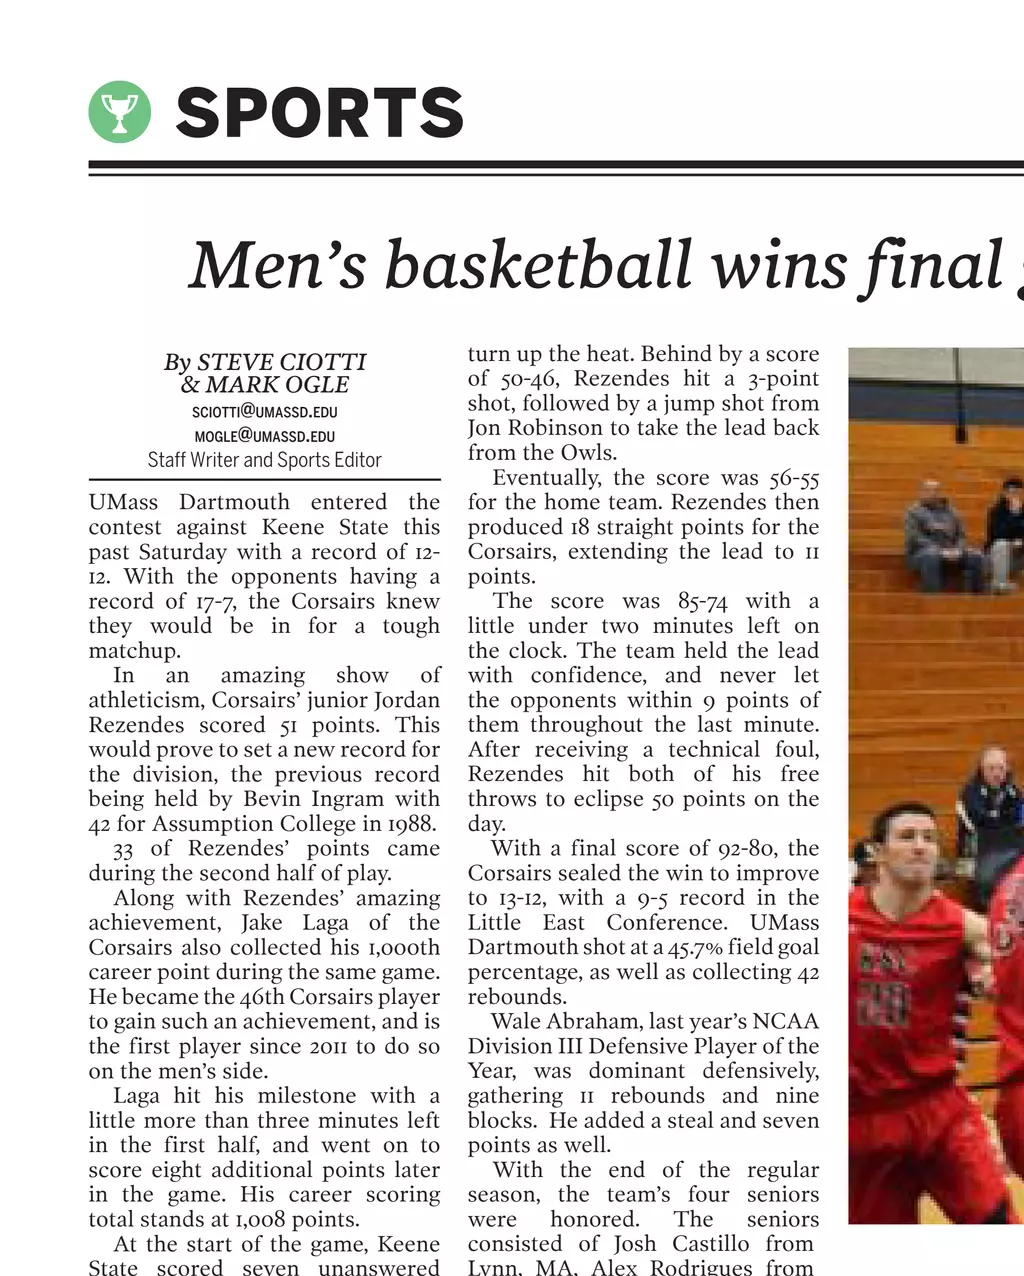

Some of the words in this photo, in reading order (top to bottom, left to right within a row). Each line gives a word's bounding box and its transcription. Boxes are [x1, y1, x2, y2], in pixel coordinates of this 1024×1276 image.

[176, 87, 463, 138] SPORTS
[386, 237, 692, 289] basketball
[711, 237, 847, 289] wins
[857, 237, 1002, 303] final
[164, 353, 191, 375] By
[198, 353, 274, 371] STEVE
[280, 353, 367, 371] CIOTTI
[469, 348, 510, 361] turn
[517, 350, 541, 366] up
[549, 344, 580, 362] the
[587, 344, 634, 362] heat.
[641, 344, 712, 362] Behind
[719, 344, 742, 366] by
[750, 350, 759, 362] a
[767, 350, 819, 362] score
[181, 376, 200, 393] &
[205, 376, 280, 393] MARK
[286, 376, 349, 393] OGLE
[193, 402, 337, 418] SCIOTTI@UMASSD.EDU
[196, 426, 334, 442] MOGLE@UMASSD.EDU
[148, 451, 186, 467] Staff
[191, 452, 239, 467] Writer
[244, 452, 272, 467] and
[278, 451, 330, 471] Sports
[336, 451, 382, 467] Editor
[89, 494, 157, 510] UMass
[180, 492, 289, 510] Dartmouth
[312, 493, 387, 510] entered
[409, 492, 440, 510] the
[89, 1210, 133, 1227] total
[141, 1210, 204, 1227] stands
[212, 1213, 229, 1227] at
[237, 1210, 285, 1229] 1,008
[292, 1210, 359, 1231] points.
